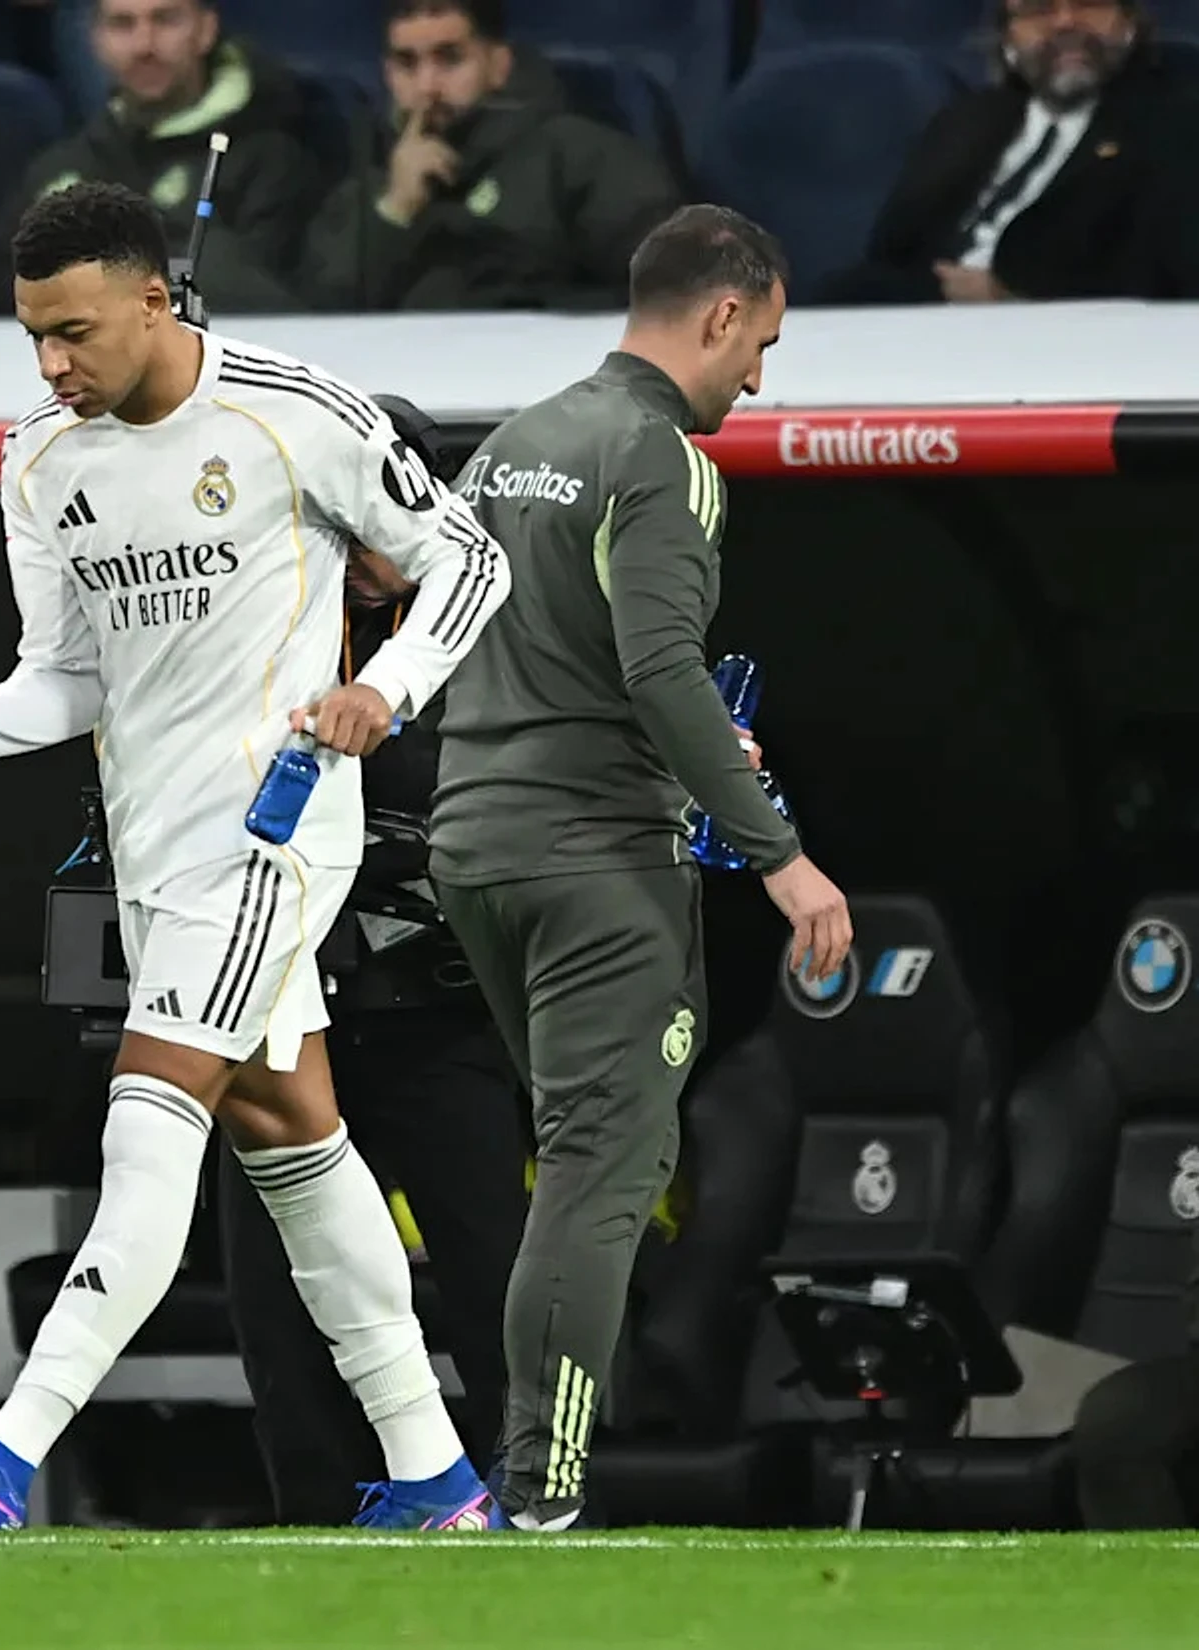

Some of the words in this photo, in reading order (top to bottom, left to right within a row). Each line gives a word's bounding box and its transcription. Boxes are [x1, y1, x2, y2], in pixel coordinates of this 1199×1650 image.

[780, 420, 959, 466] Emirates
[483, 462, 585, 505] Sanitas
[70, 540, 239, 592] Emirates
[107, 596, 130, 631] LY
[138, 586, 210, 626] BETTER
